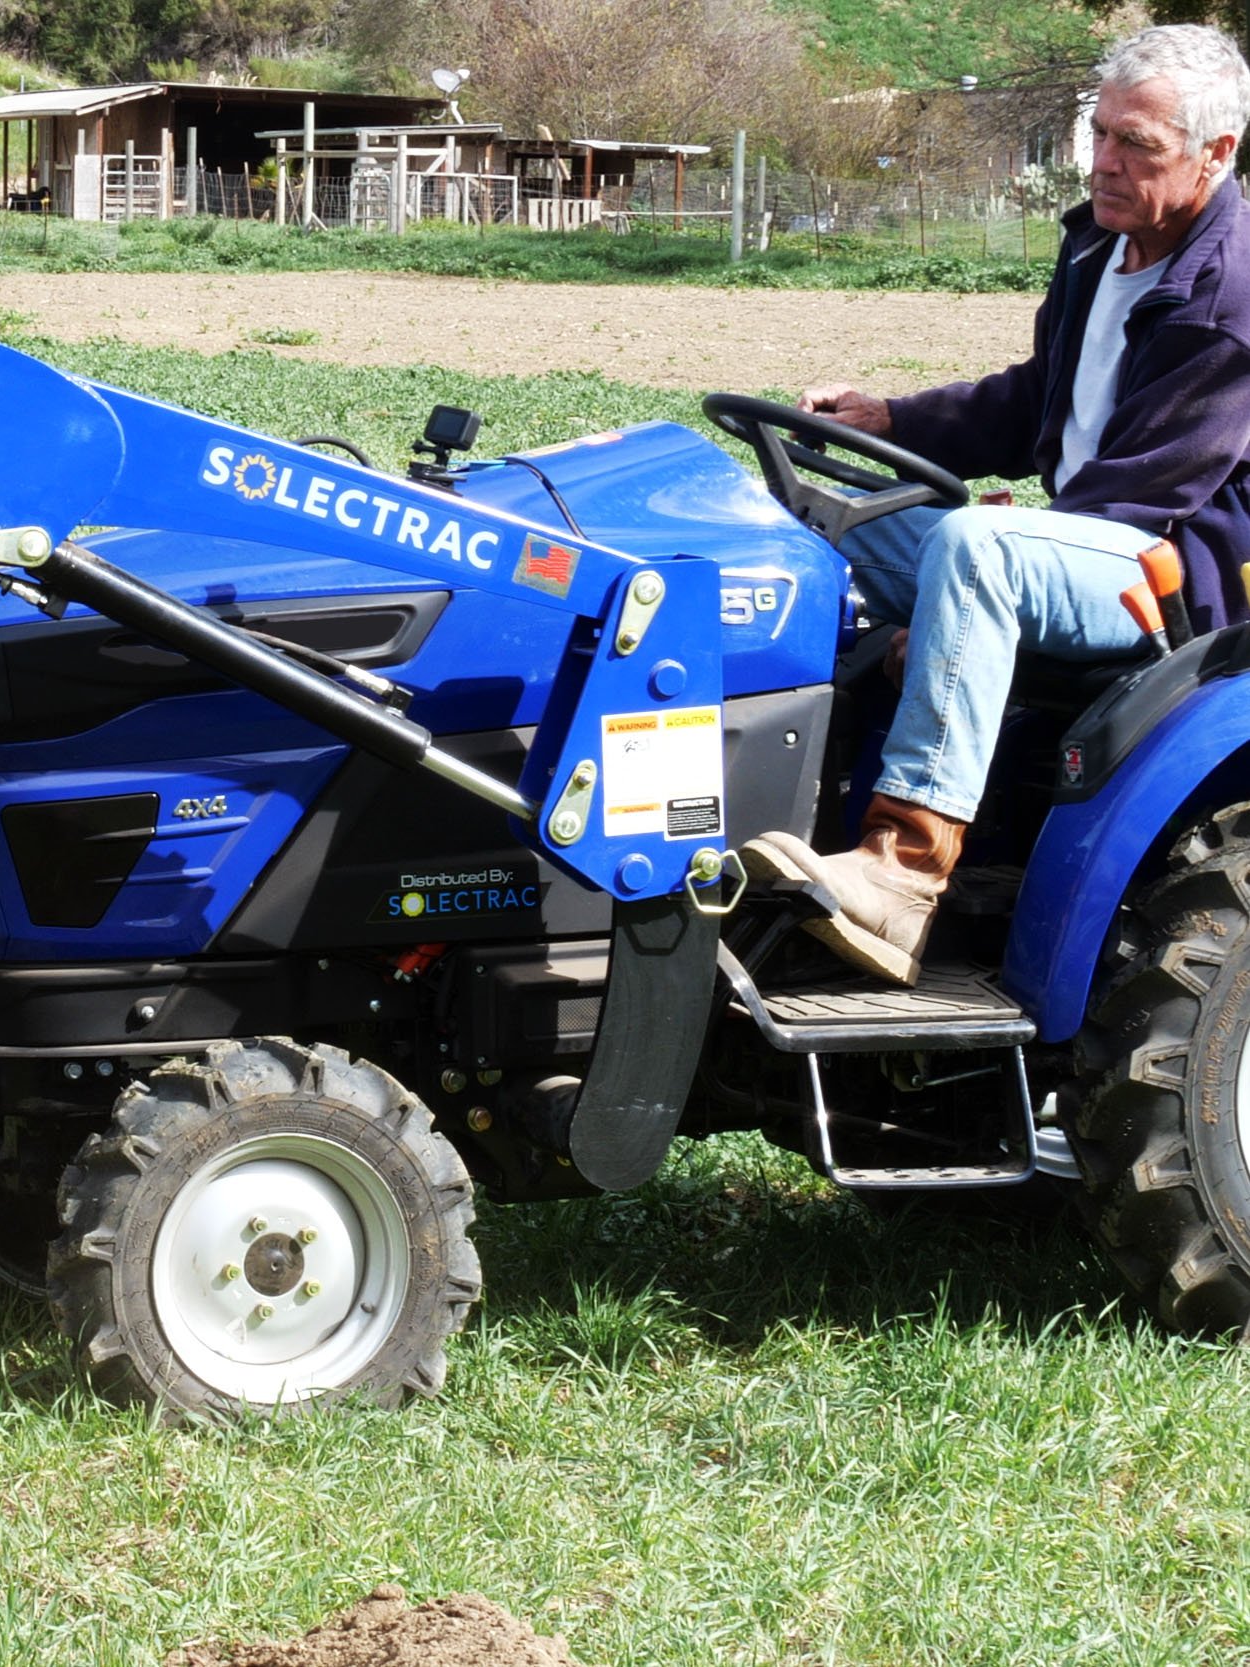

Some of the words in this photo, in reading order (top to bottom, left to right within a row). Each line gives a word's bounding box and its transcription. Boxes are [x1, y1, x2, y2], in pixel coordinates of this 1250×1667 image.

[202, 446, 499, 570] SOLECTRAC
[617, 720, 657, 732] WARNING
[674, 714, 715, 727] CAUTION
[401, 870, 487, 888] Distributed
[489, 869, 514, 884] By:
[388, 886, 536, 917] SOLECTRAC
